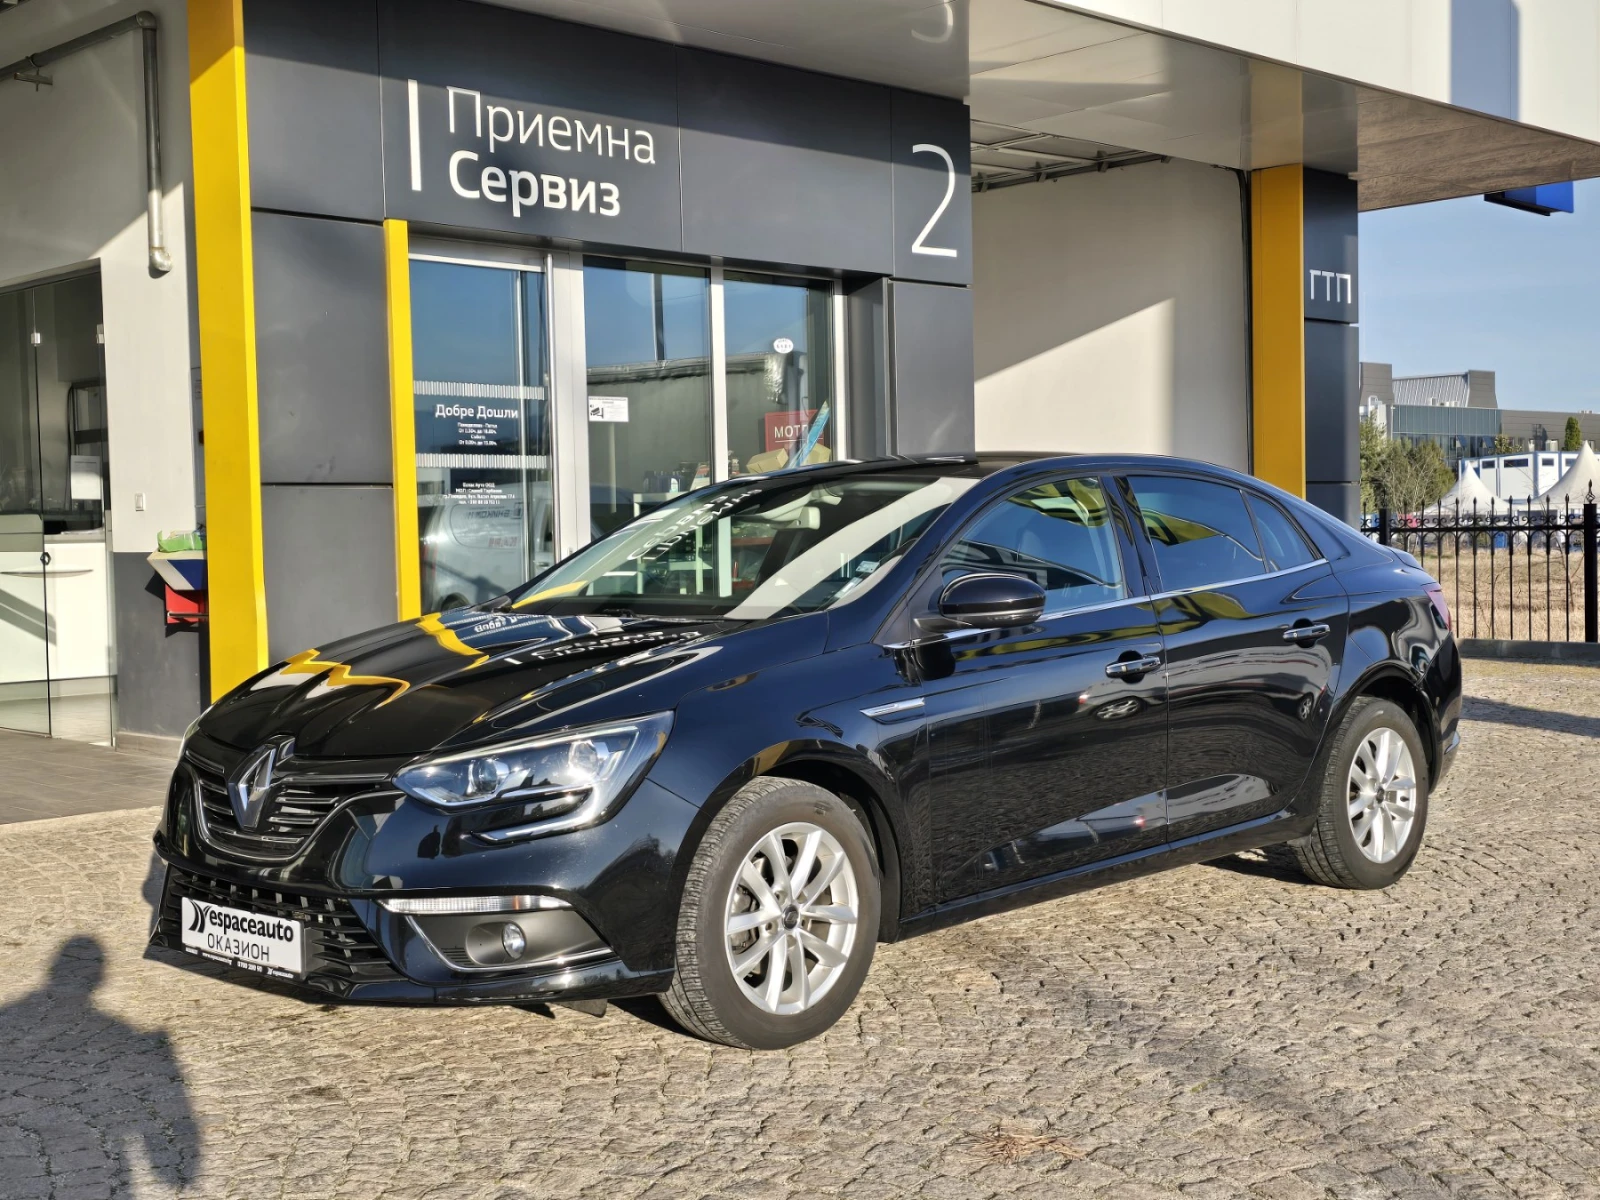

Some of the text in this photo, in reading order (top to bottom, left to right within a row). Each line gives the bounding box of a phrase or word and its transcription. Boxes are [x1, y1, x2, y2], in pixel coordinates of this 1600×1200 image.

[446, 85, 655, 165] Приемна
[449, 150, 621, 218] Сервиз
[911, 143, 957, 257] 2
[1309, 269, 1351, 304] ГТП
[435, 404, 519, 420] Добре Дошли
[209, 909, 294, 942] espaceauto
[207, 932, 270, 962] ОКАЗИОН
